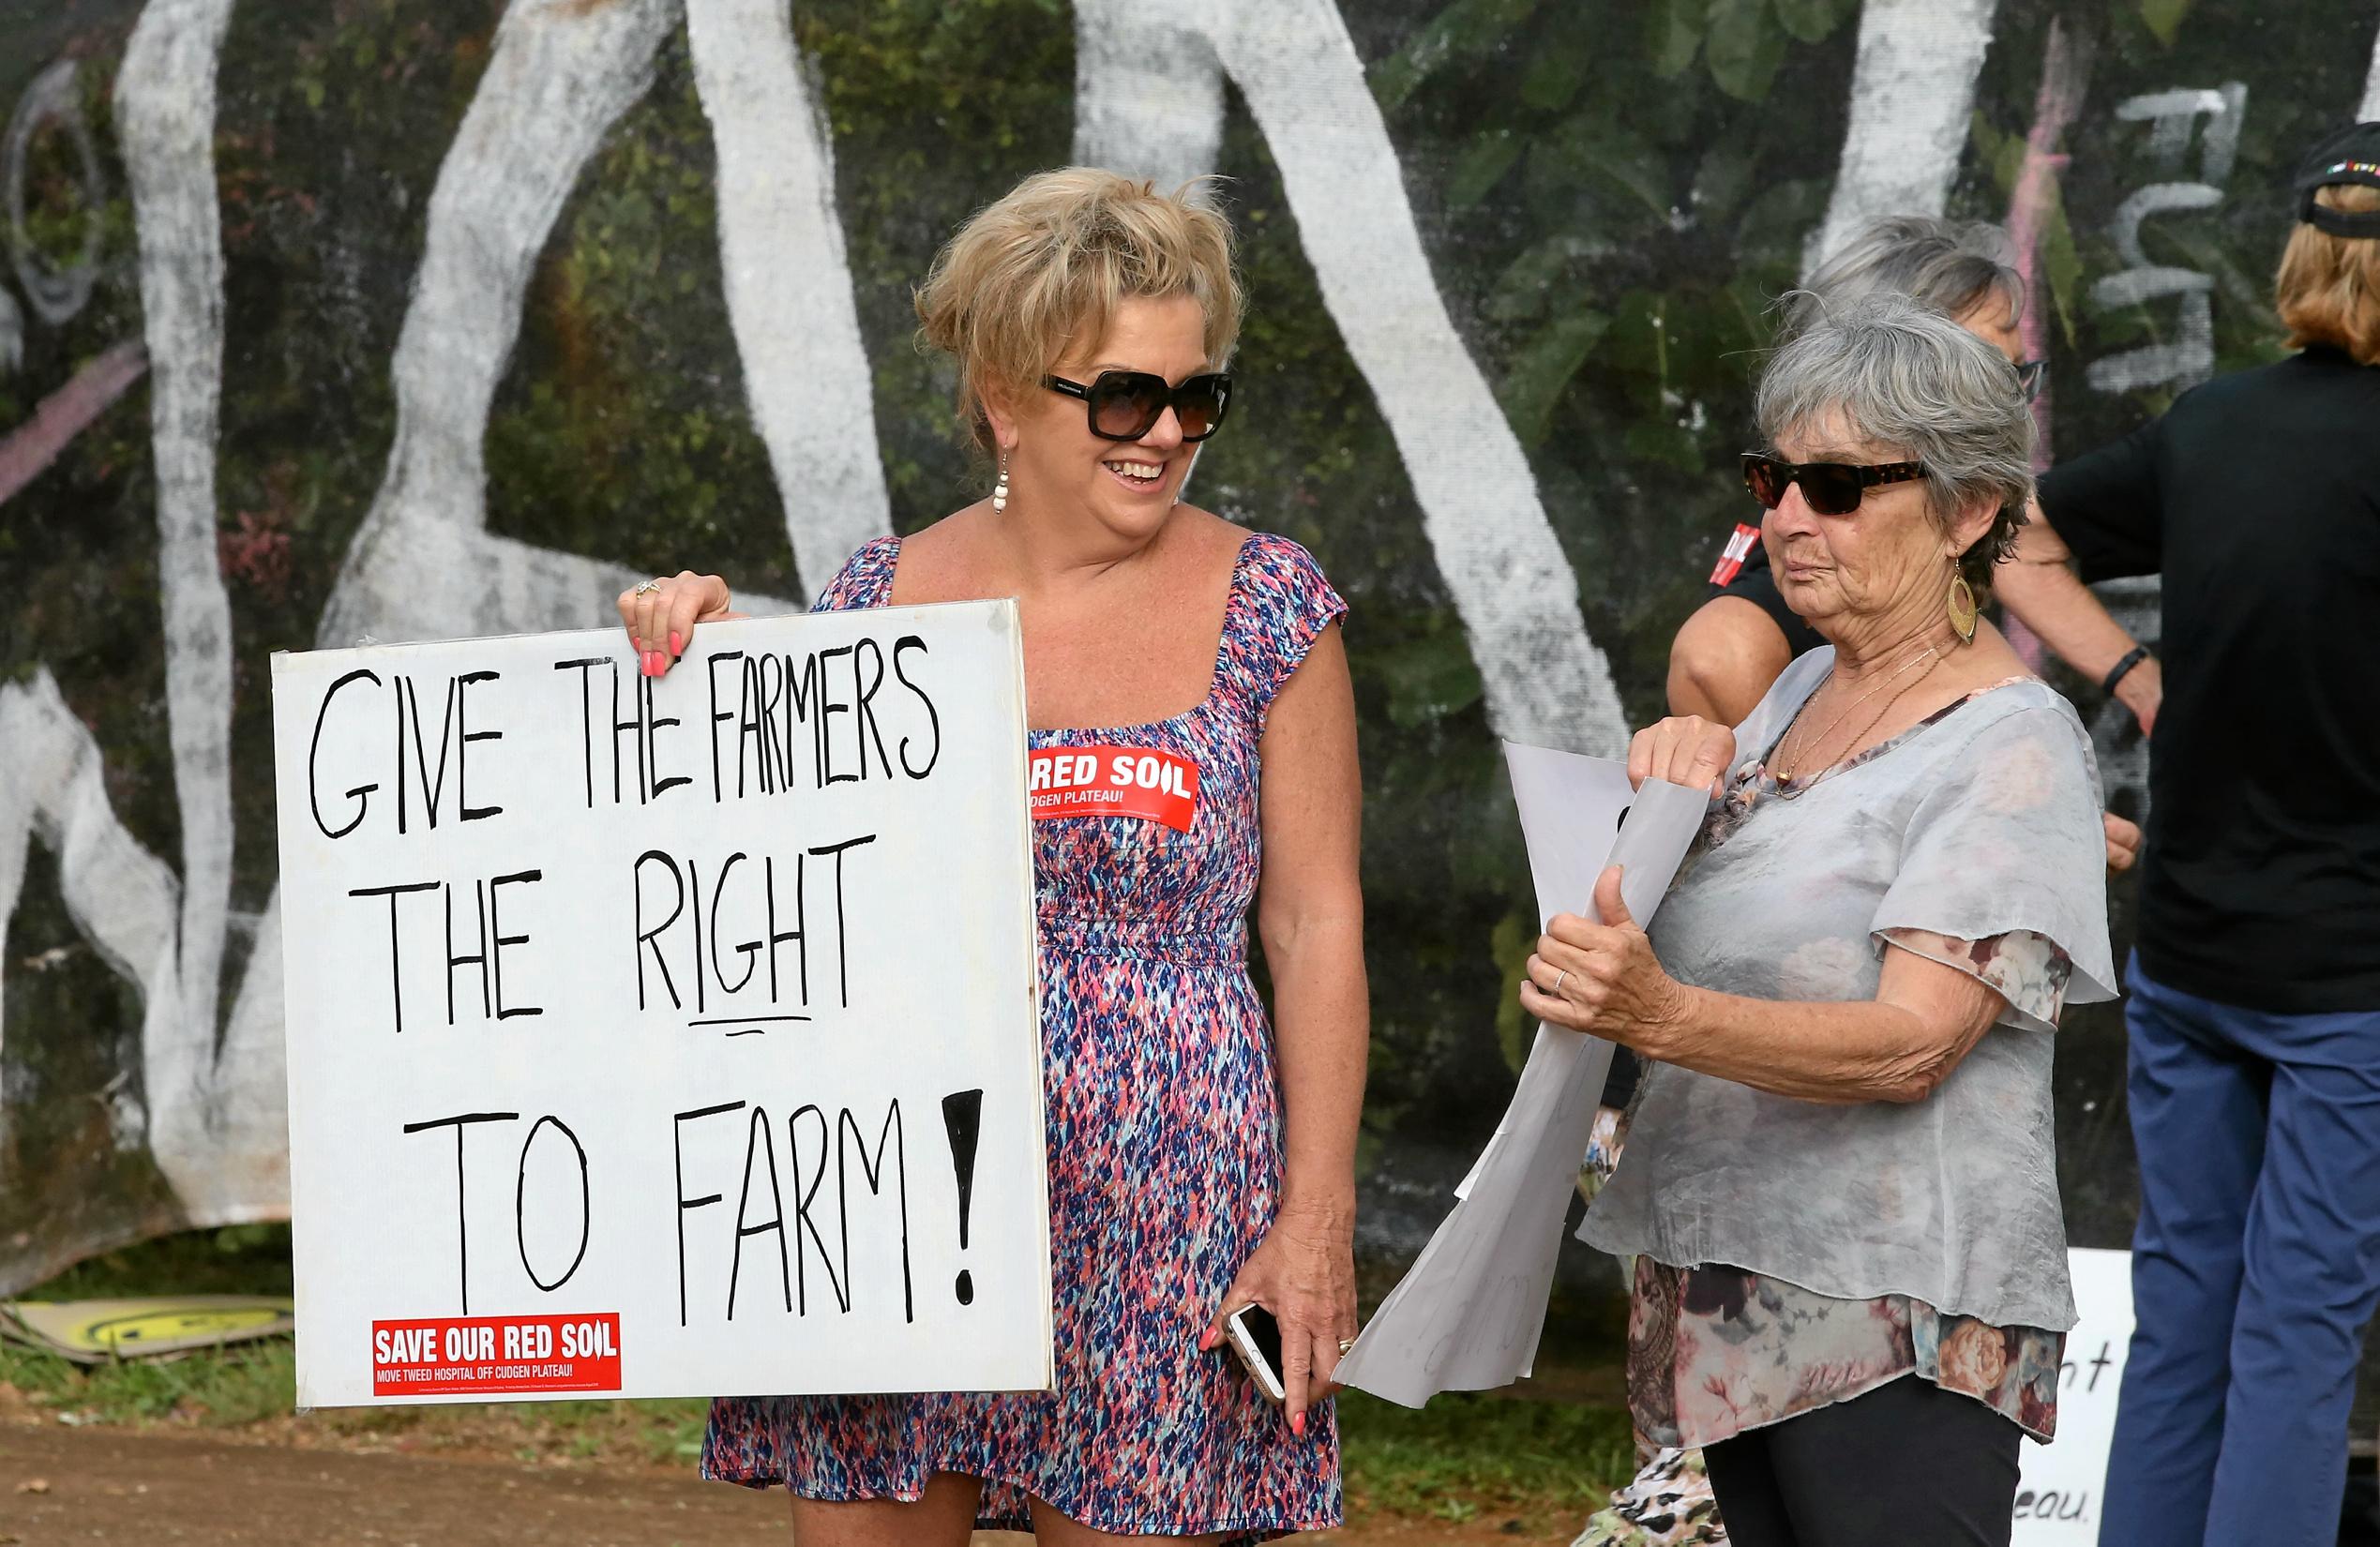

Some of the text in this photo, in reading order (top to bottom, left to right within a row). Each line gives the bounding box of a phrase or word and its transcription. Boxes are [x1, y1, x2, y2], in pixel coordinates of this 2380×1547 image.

[309, 636, 940, 839] GIVE THE FARMERS
[1030, 755, 1191, 799] RED SOIL
[1031, 789, 1123, 807] DGEN PLATEAU!
[349, 834, 877, 1032] THE RIGHT
[403, 1089, 984, 1327] TO FARM!
[375, 1318, 617, 1364] SAVE OUR RED SOIL
[377, 1363, 573, 1383] MOVE TWEED HOSPITAL OFF CUDGEN PLATEAU!
[2014, 1491, 2088, 1524] eau.
